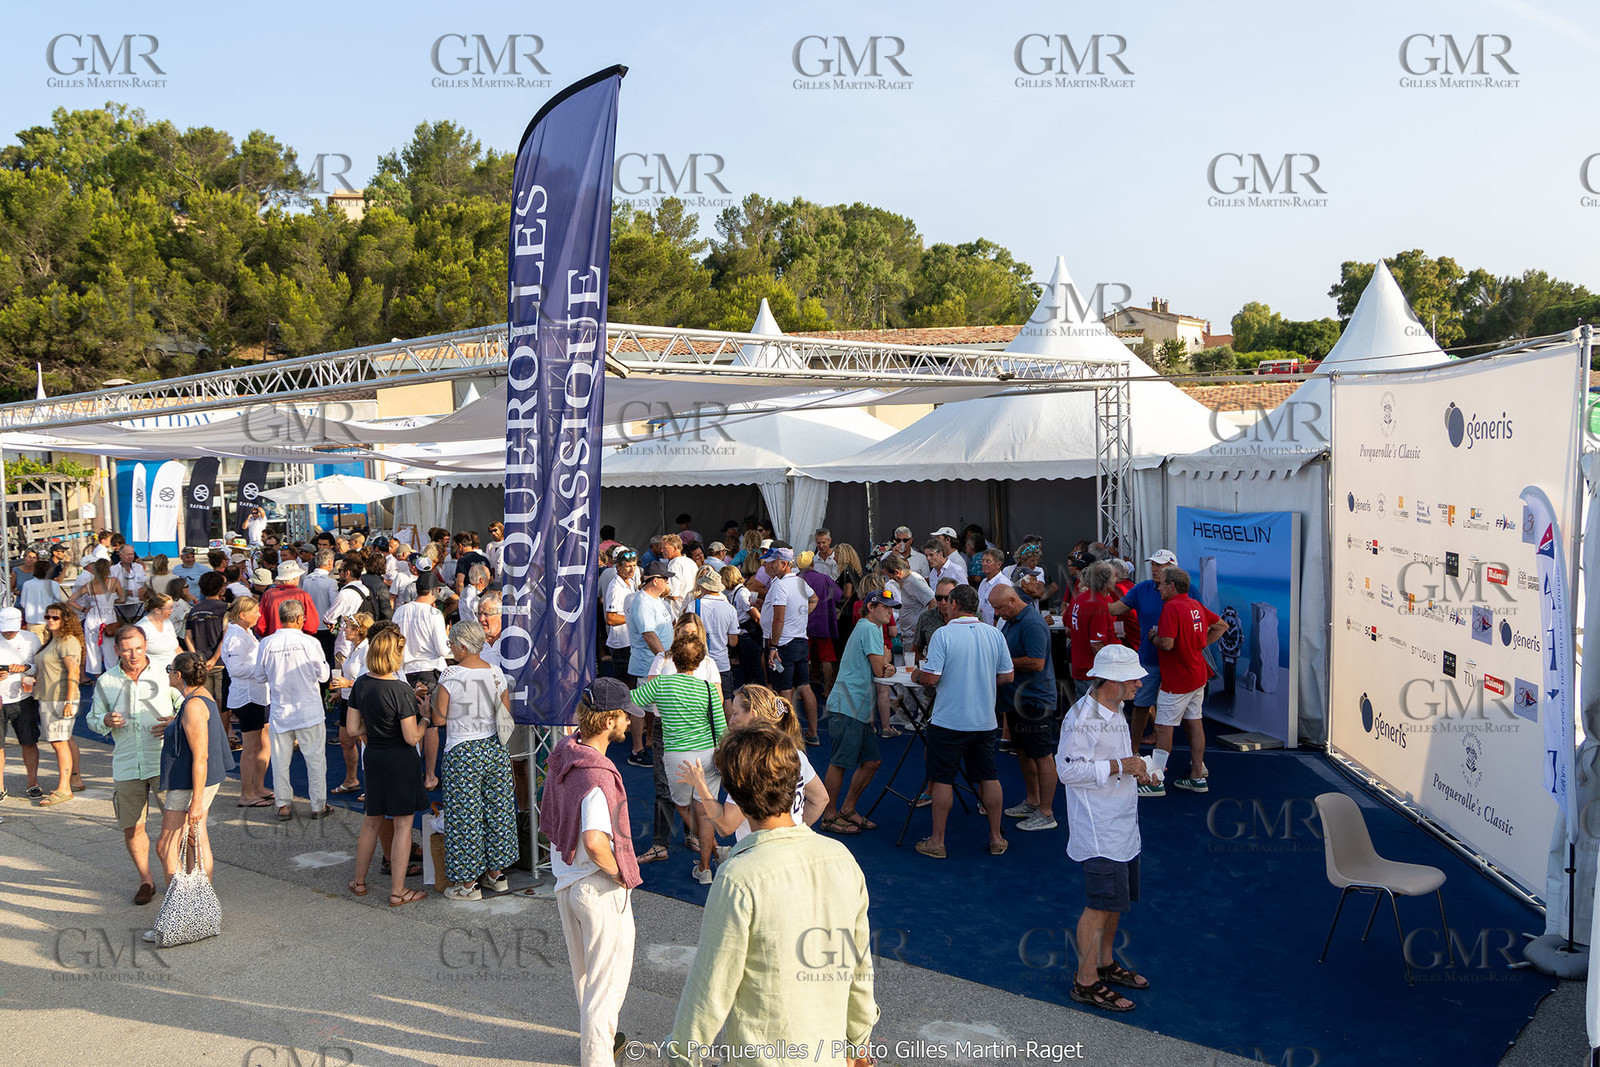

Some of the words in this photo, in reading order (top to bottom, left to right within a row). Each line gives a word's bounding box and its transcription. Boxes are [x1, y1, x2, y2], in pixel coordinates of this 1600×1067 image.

[553, 264, 600, 624] CLASSIQUE
[1192, 521, 1272, 544] HERBELIN
[1190, 610, 1200, 620] 12
[1486, 676, 1504, 692] Malongo
[1432, 772, 1481, 816] Porquerolle's
[1484, 806, 1514, 836] Classic
